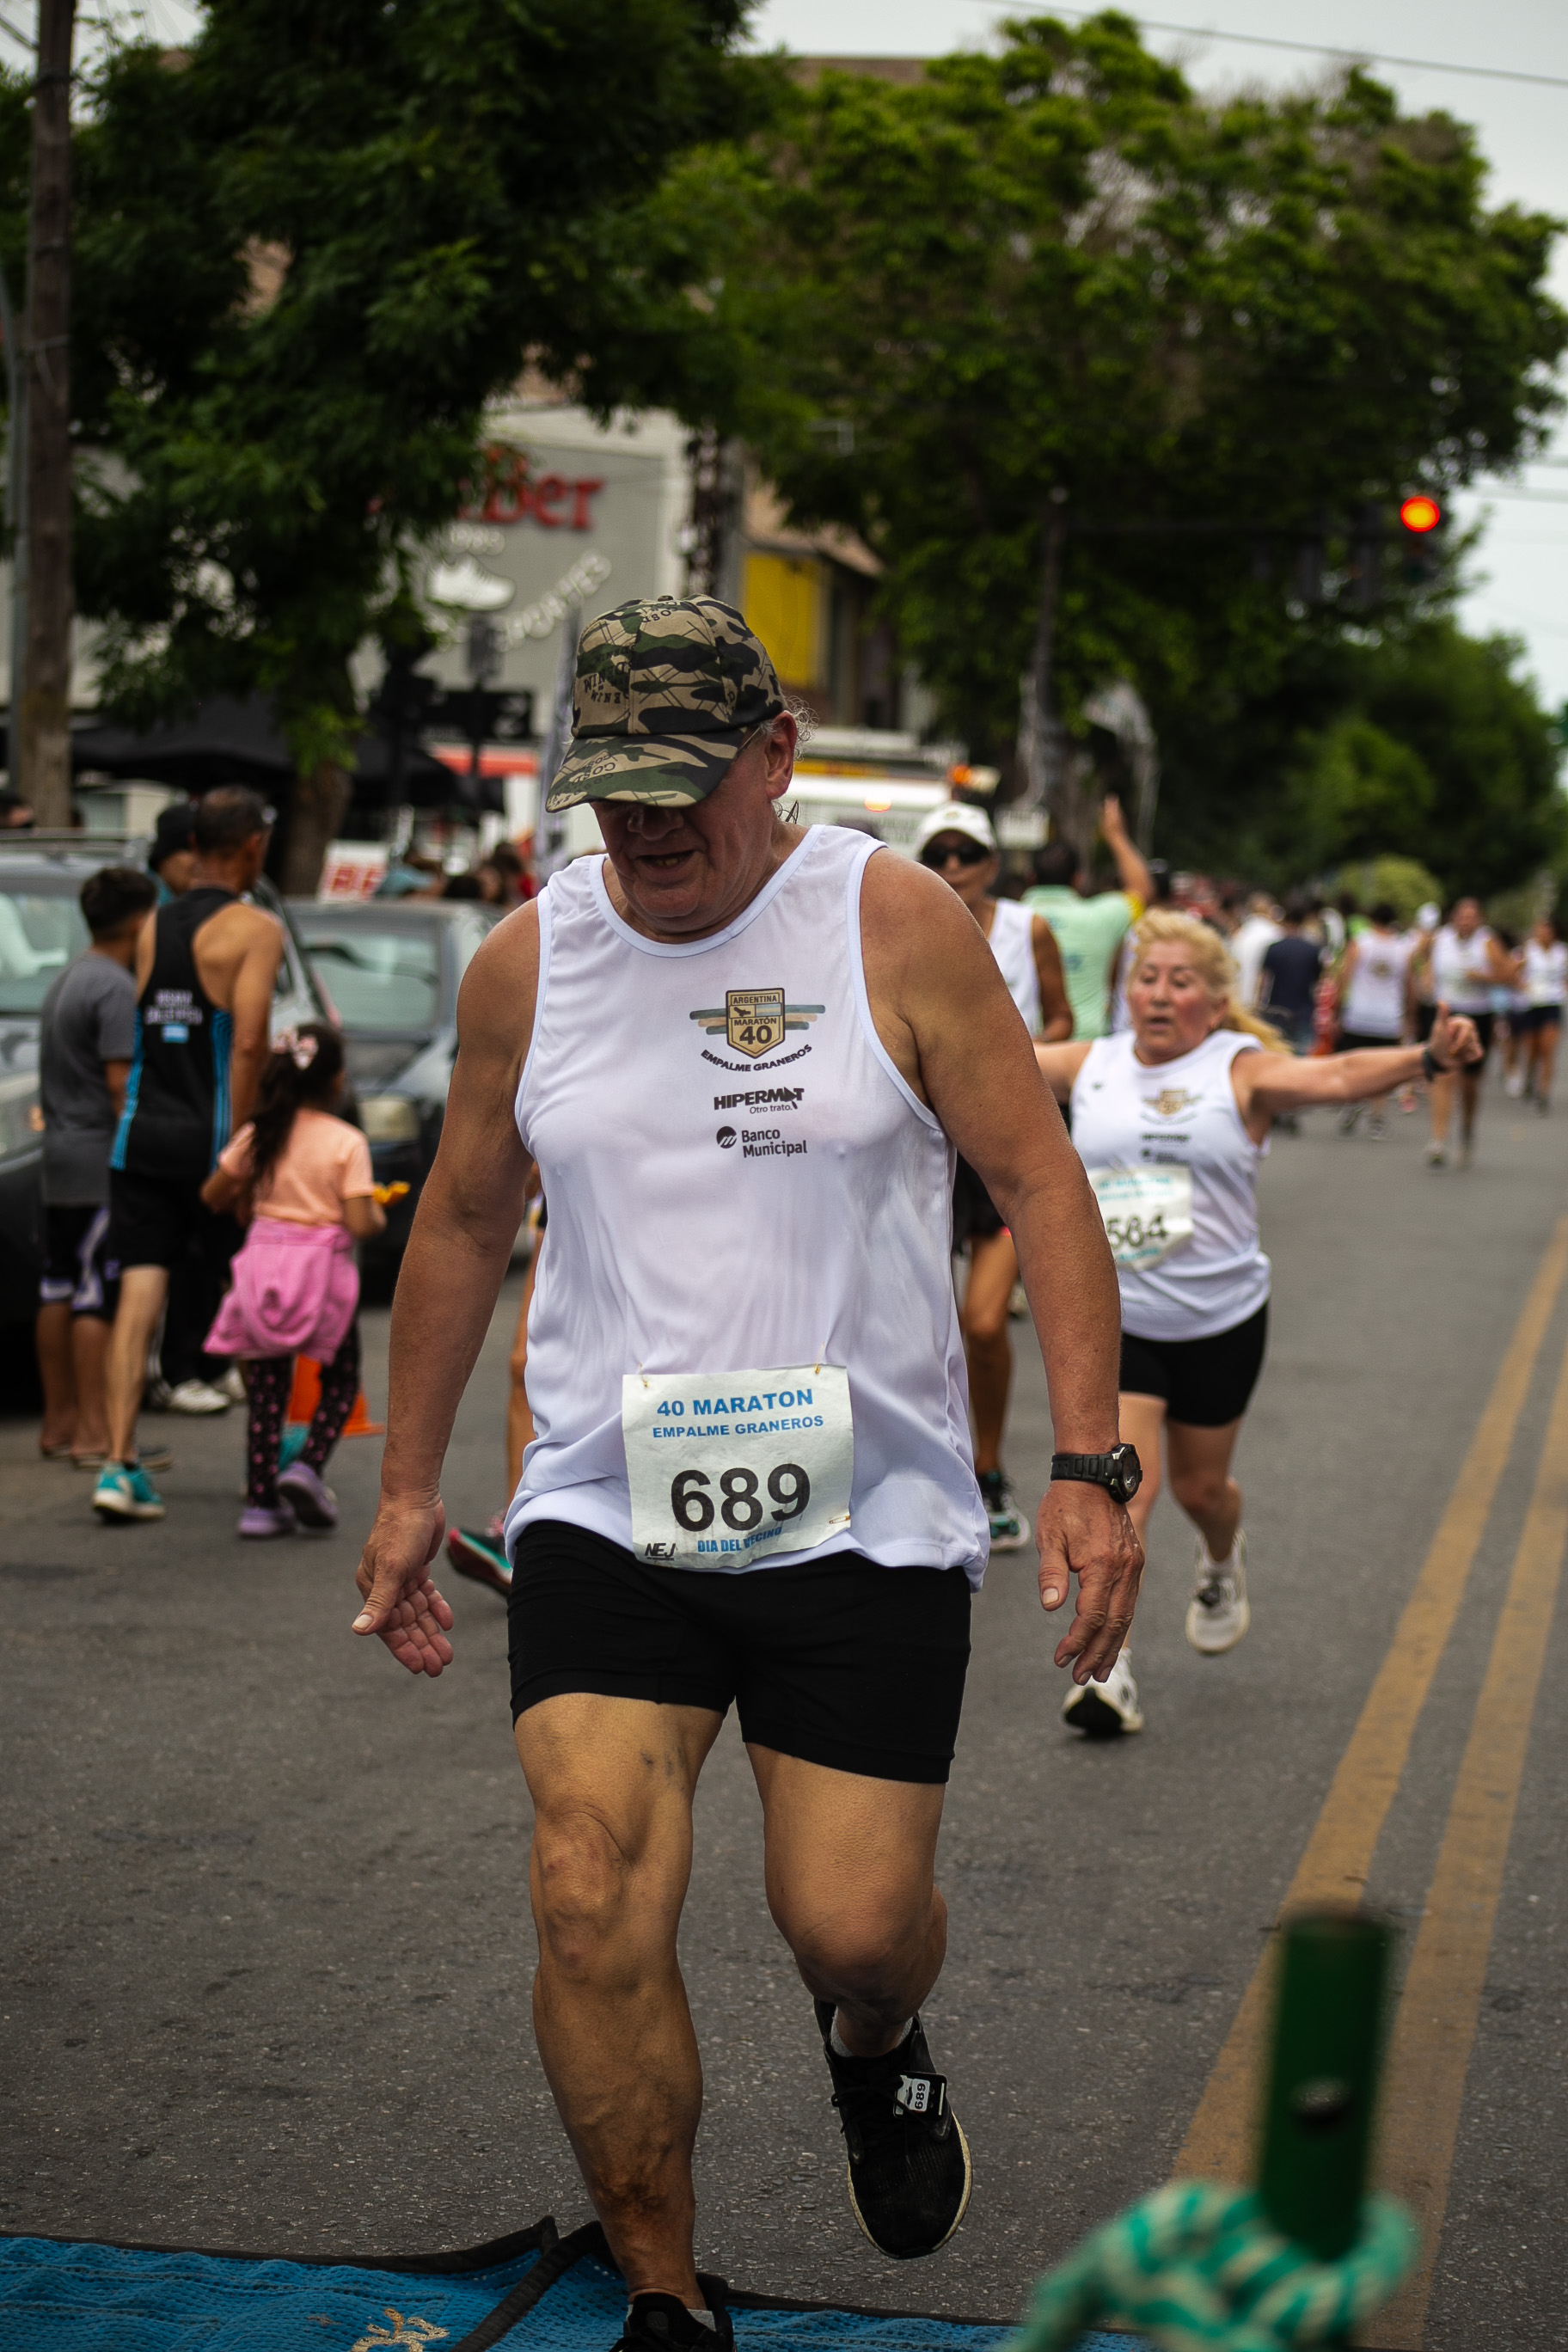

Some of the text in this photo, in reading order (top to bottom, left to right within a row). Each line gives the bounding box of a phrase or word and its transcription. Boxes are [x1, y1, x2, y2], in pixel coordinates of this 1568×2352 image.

[733, 995, 778, 1004] ARGENTINA
[734, 1016, 777, 1026] MARATÓN
[739, 1025, 773, 1044] 40
[701, 1044, 812, 1072] EMPALME GRANEROS
[750, 1106, 769, 1115] Otro
[741, 1129, 781, 1143] Banco
[743, 1140, 808, 1158] Municipal
[657, 1388, 813, 1417] 40 MARATON
[652, 1415, 824, 1438] EMPALME GRANEROS
[671, 1463, 811, 1532] 689
[697, 1527, 782, 1553] DIA DEL VECINO
[645, 1543, 677, 1558] NEJ
[914, 2083, 926, 2110] 689
